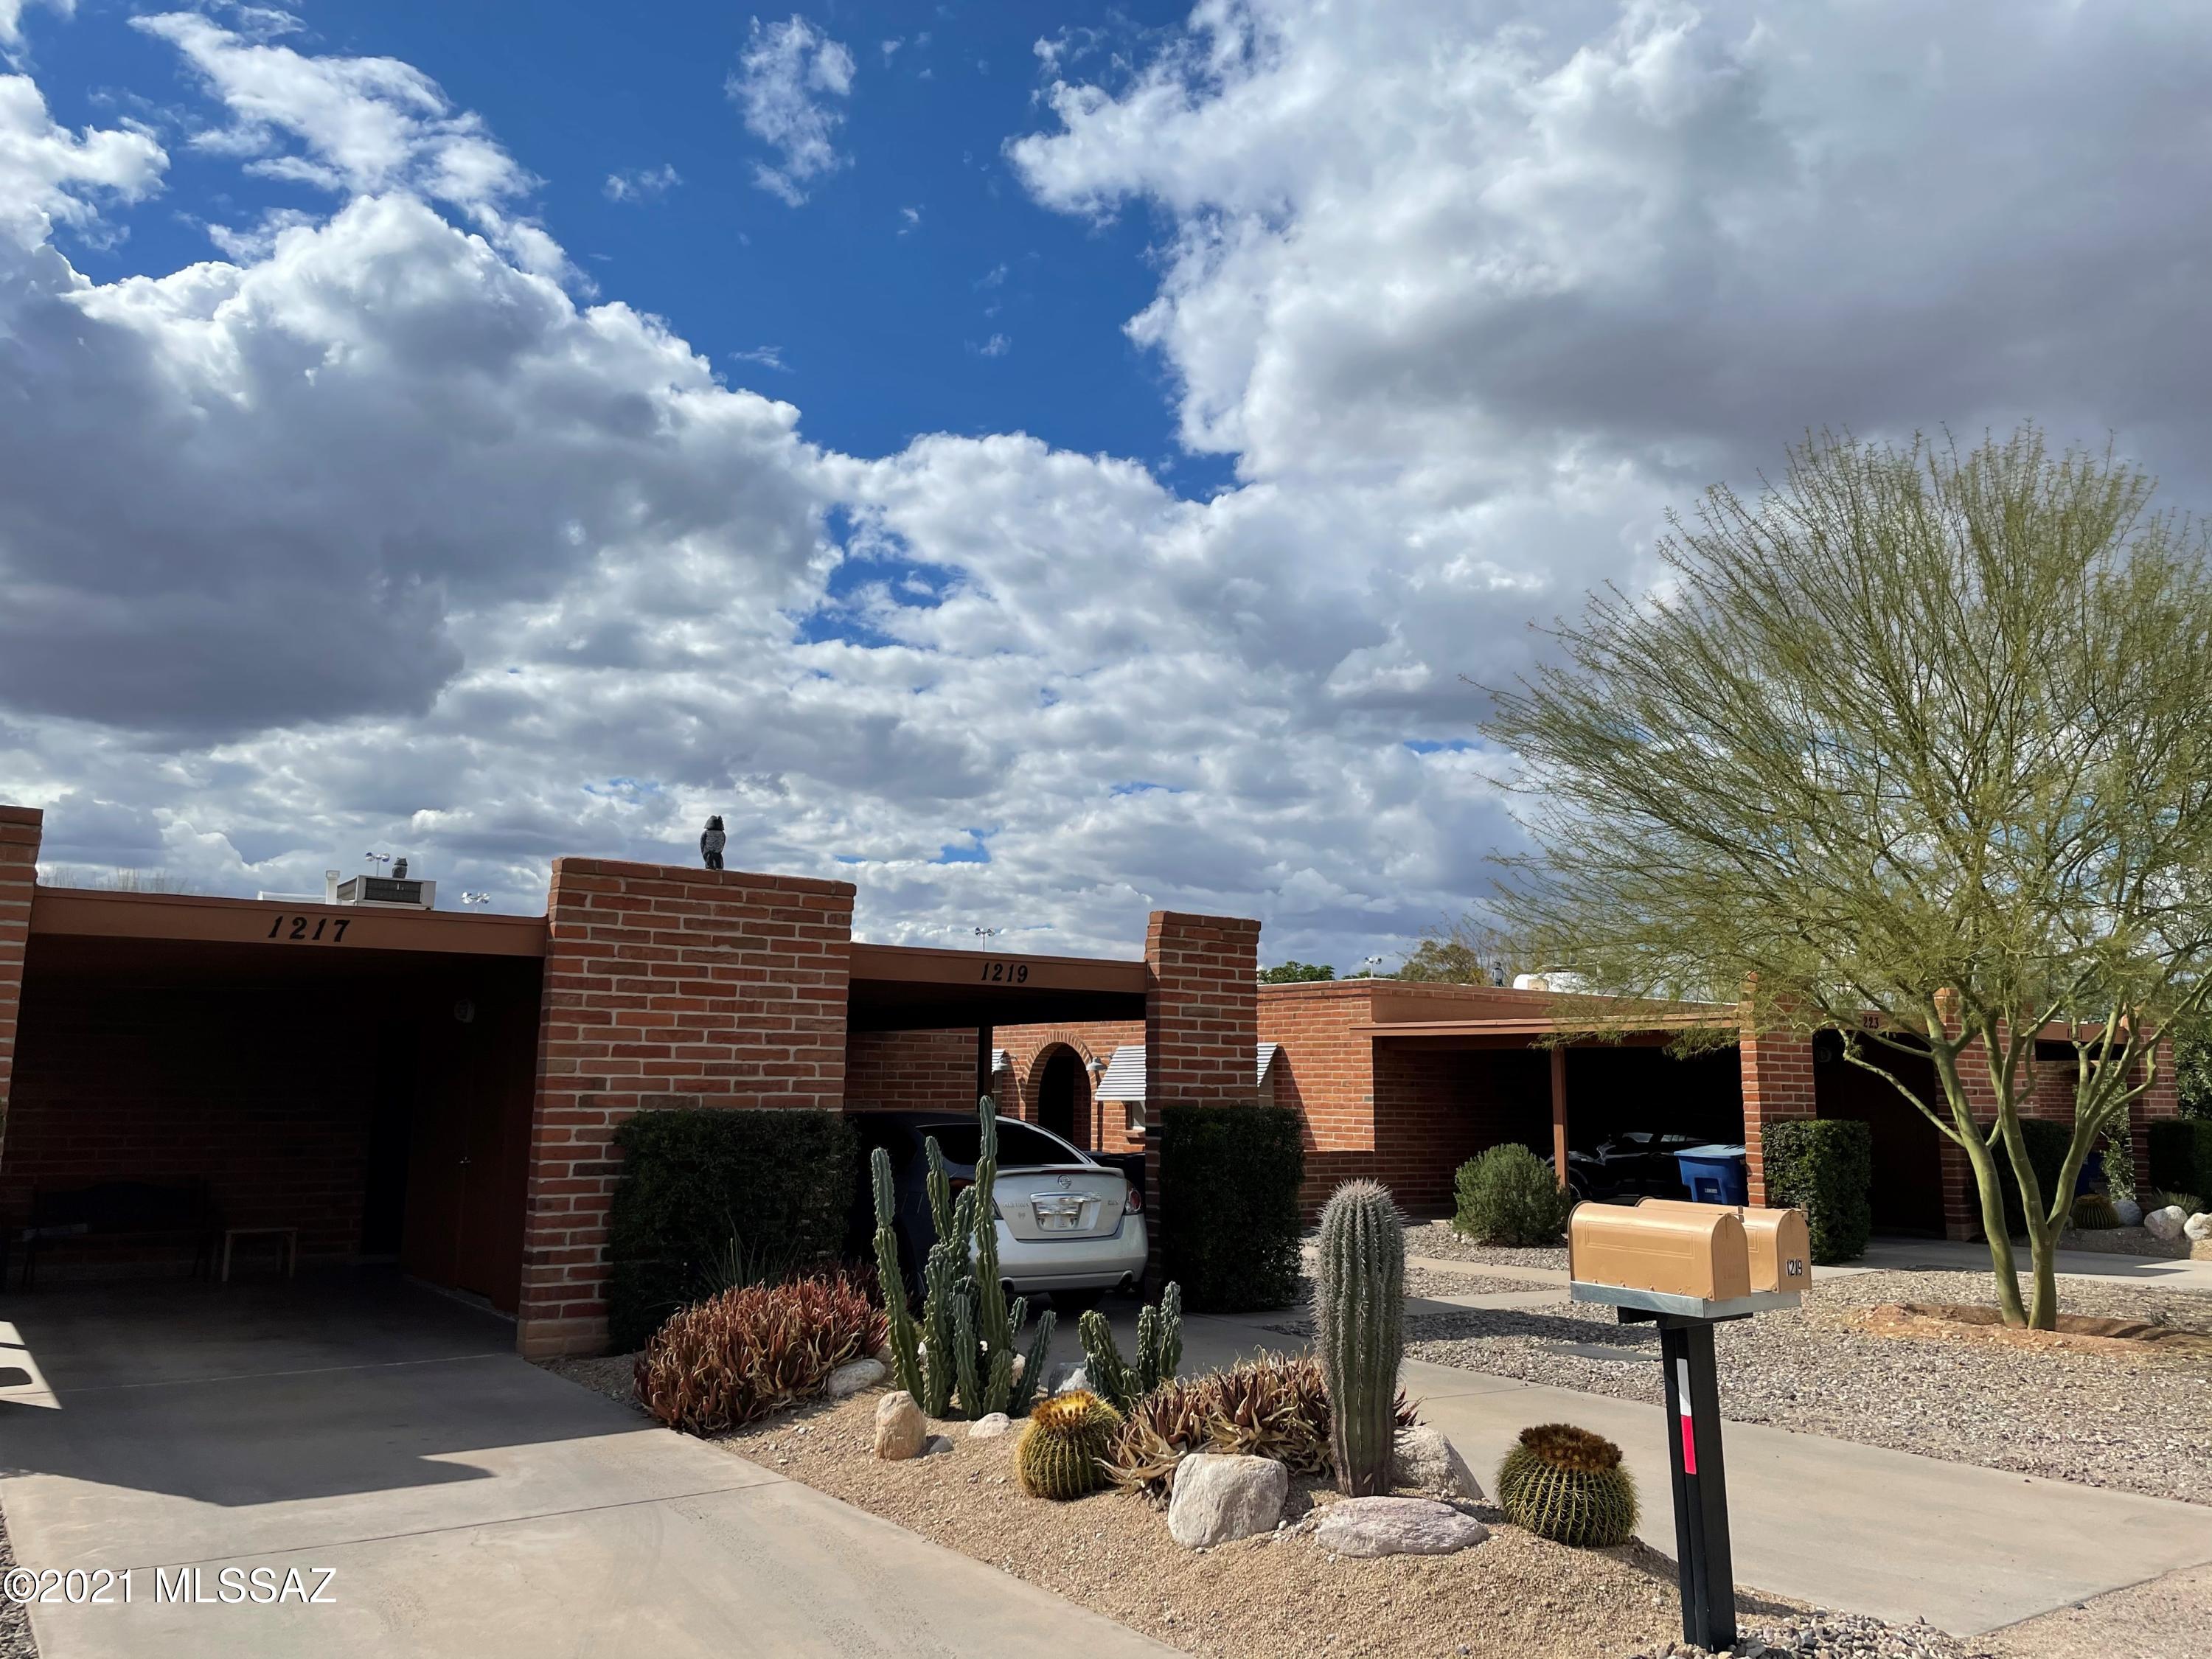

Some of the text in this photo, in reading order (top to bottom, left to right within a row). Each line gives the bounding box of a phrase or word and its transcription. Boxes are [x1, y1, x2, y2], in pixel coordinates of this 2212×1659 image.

[268, 916, 351, 942] 1217
[981, 962, 1028, 984] 1219
[1787, 1259, 1803, 1276] 1219
